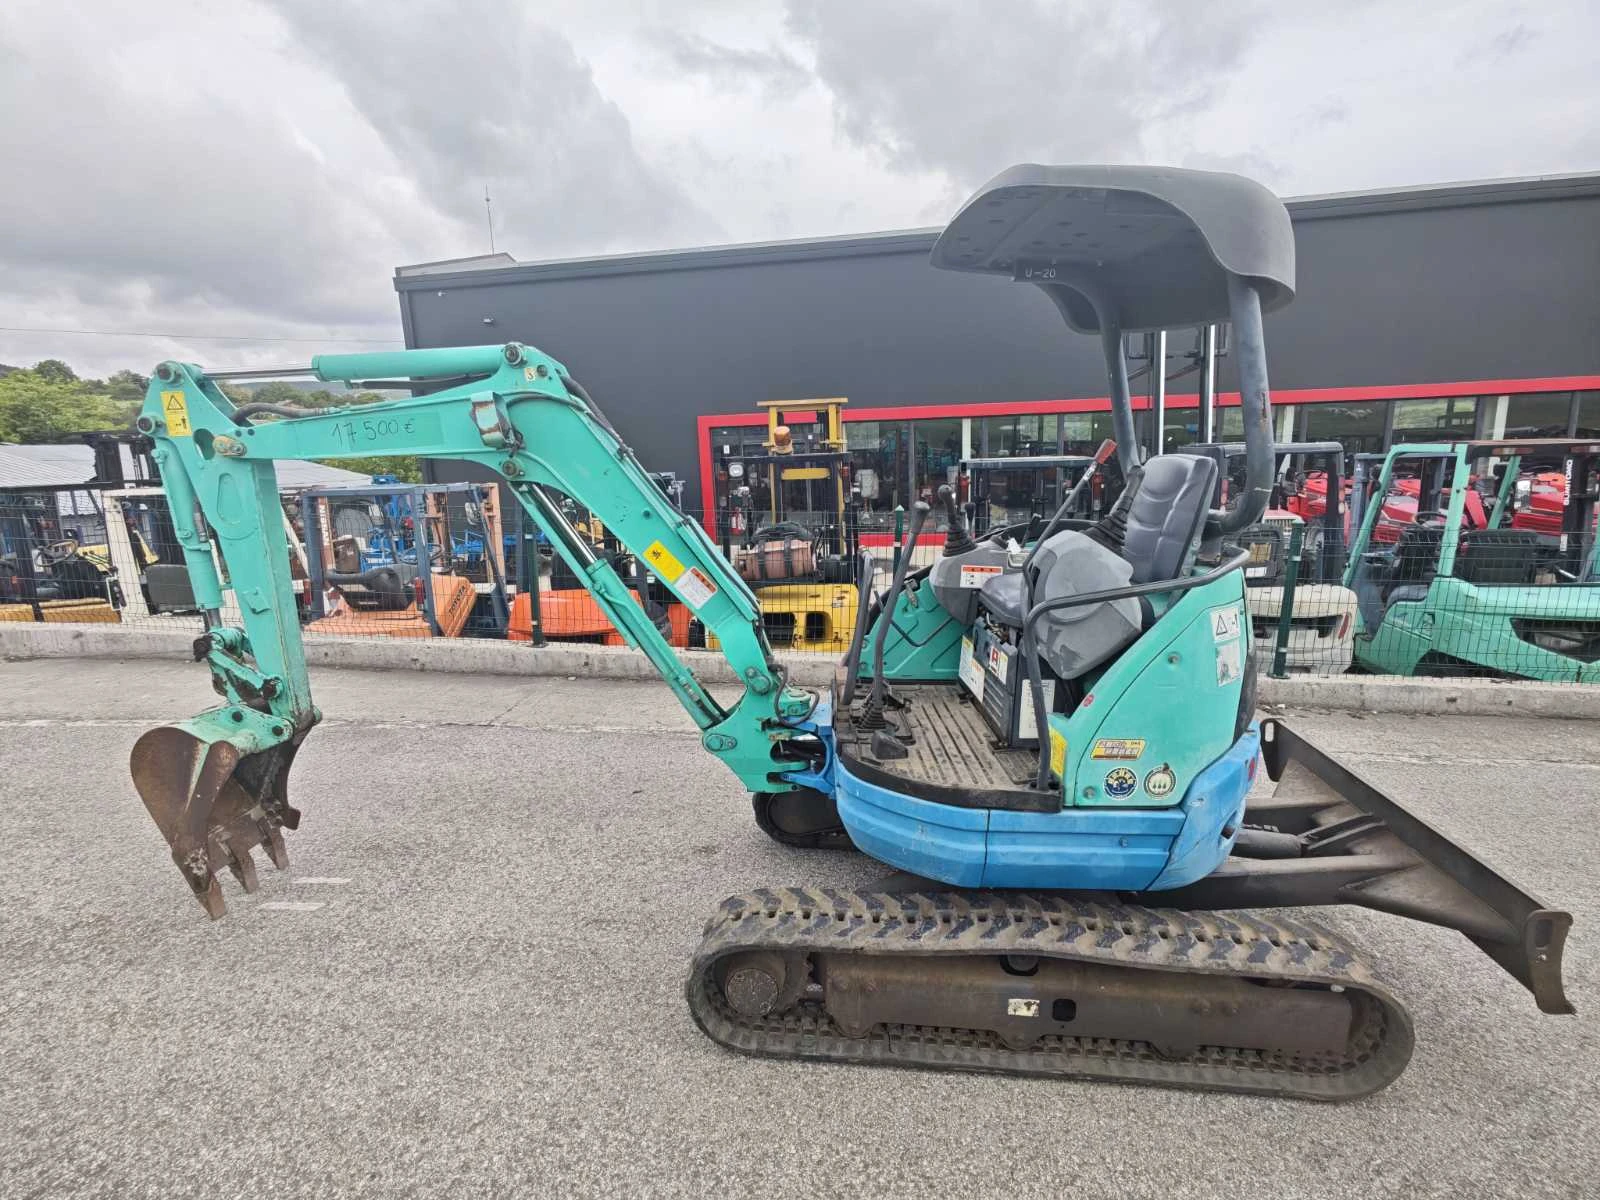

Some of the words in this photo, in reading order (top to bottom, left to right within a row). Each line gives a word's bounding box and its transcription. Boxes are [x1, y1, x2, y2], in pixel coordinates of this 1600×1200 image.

[1024, 267, 1056, 278] U-20
[332, 422, 357, 450] 17
[1563, 459, 1573, 505] SUMITOMO
[448, 585, 466, 618] TOYOTA
